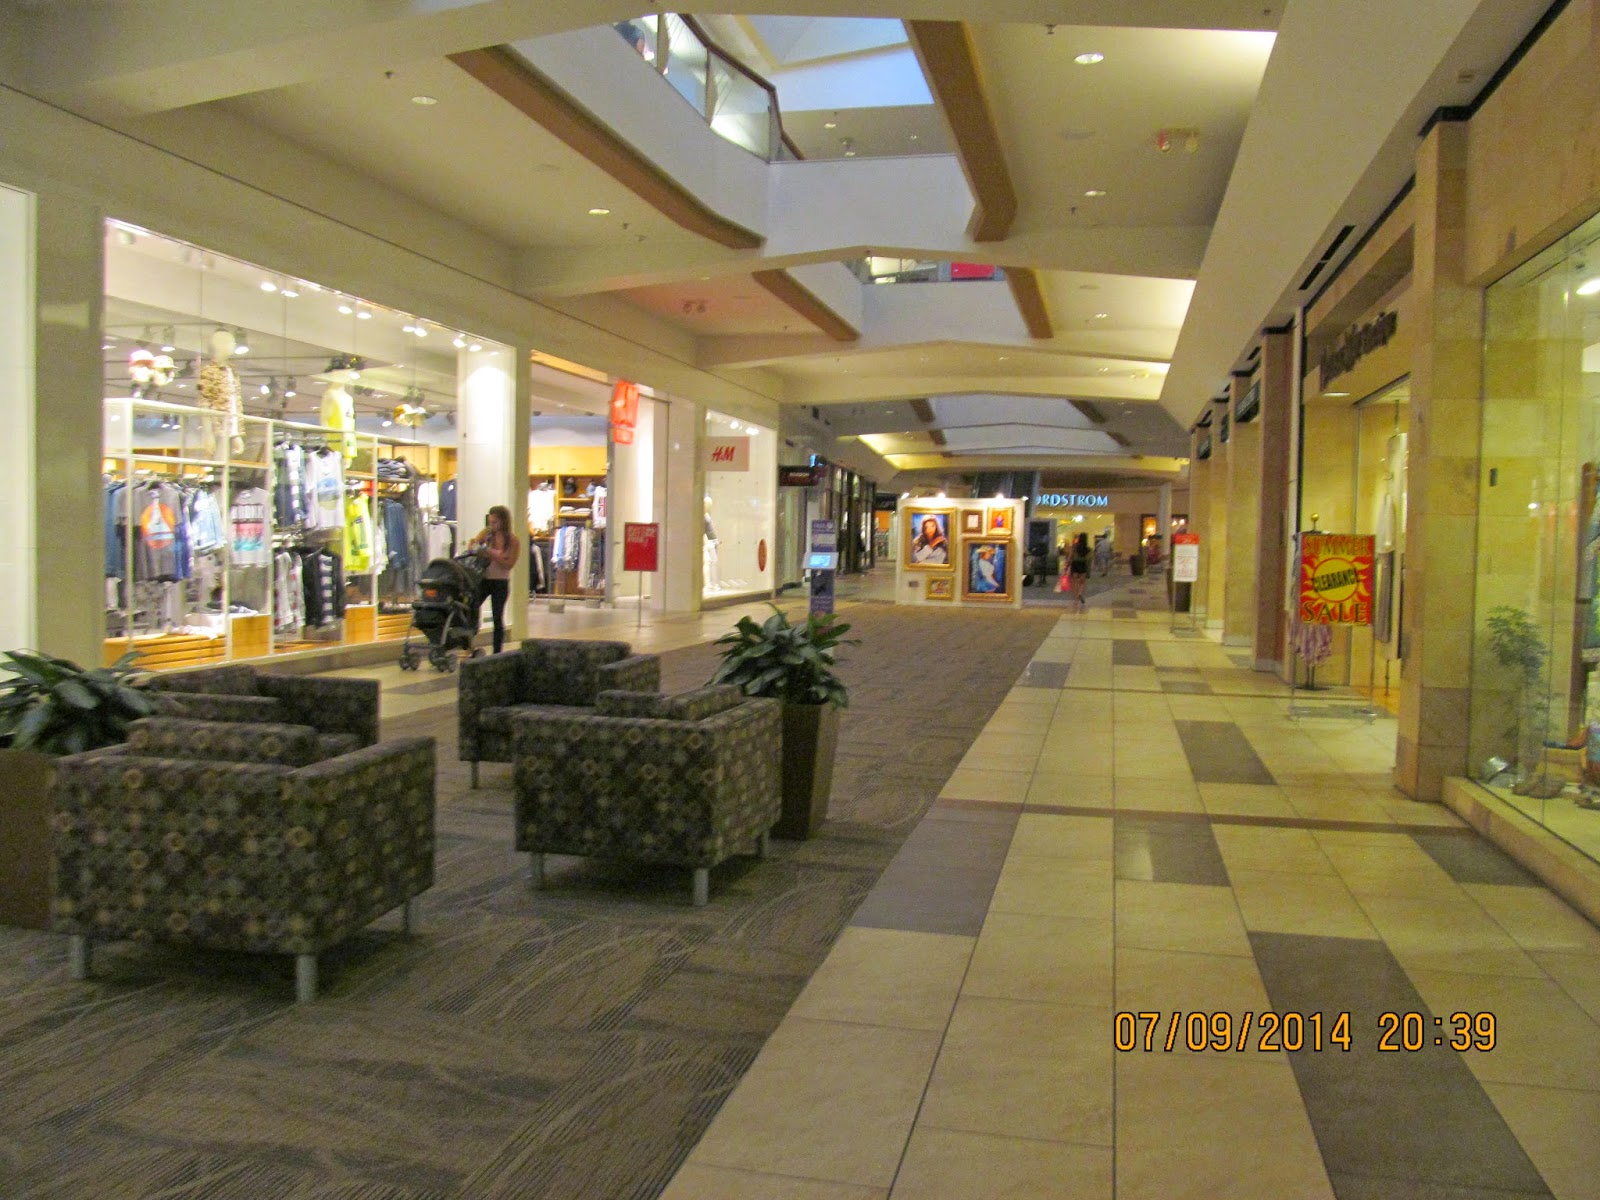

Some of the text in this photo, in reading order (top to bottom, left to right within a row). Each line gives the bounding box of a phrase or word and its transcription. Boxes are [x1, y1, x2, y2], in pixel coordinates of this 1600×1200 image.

[711, 446, 736, 462] H&M
[1304, 535, 1369, 556] SUMMER
[1302, 601, 1367, 624] SALE
